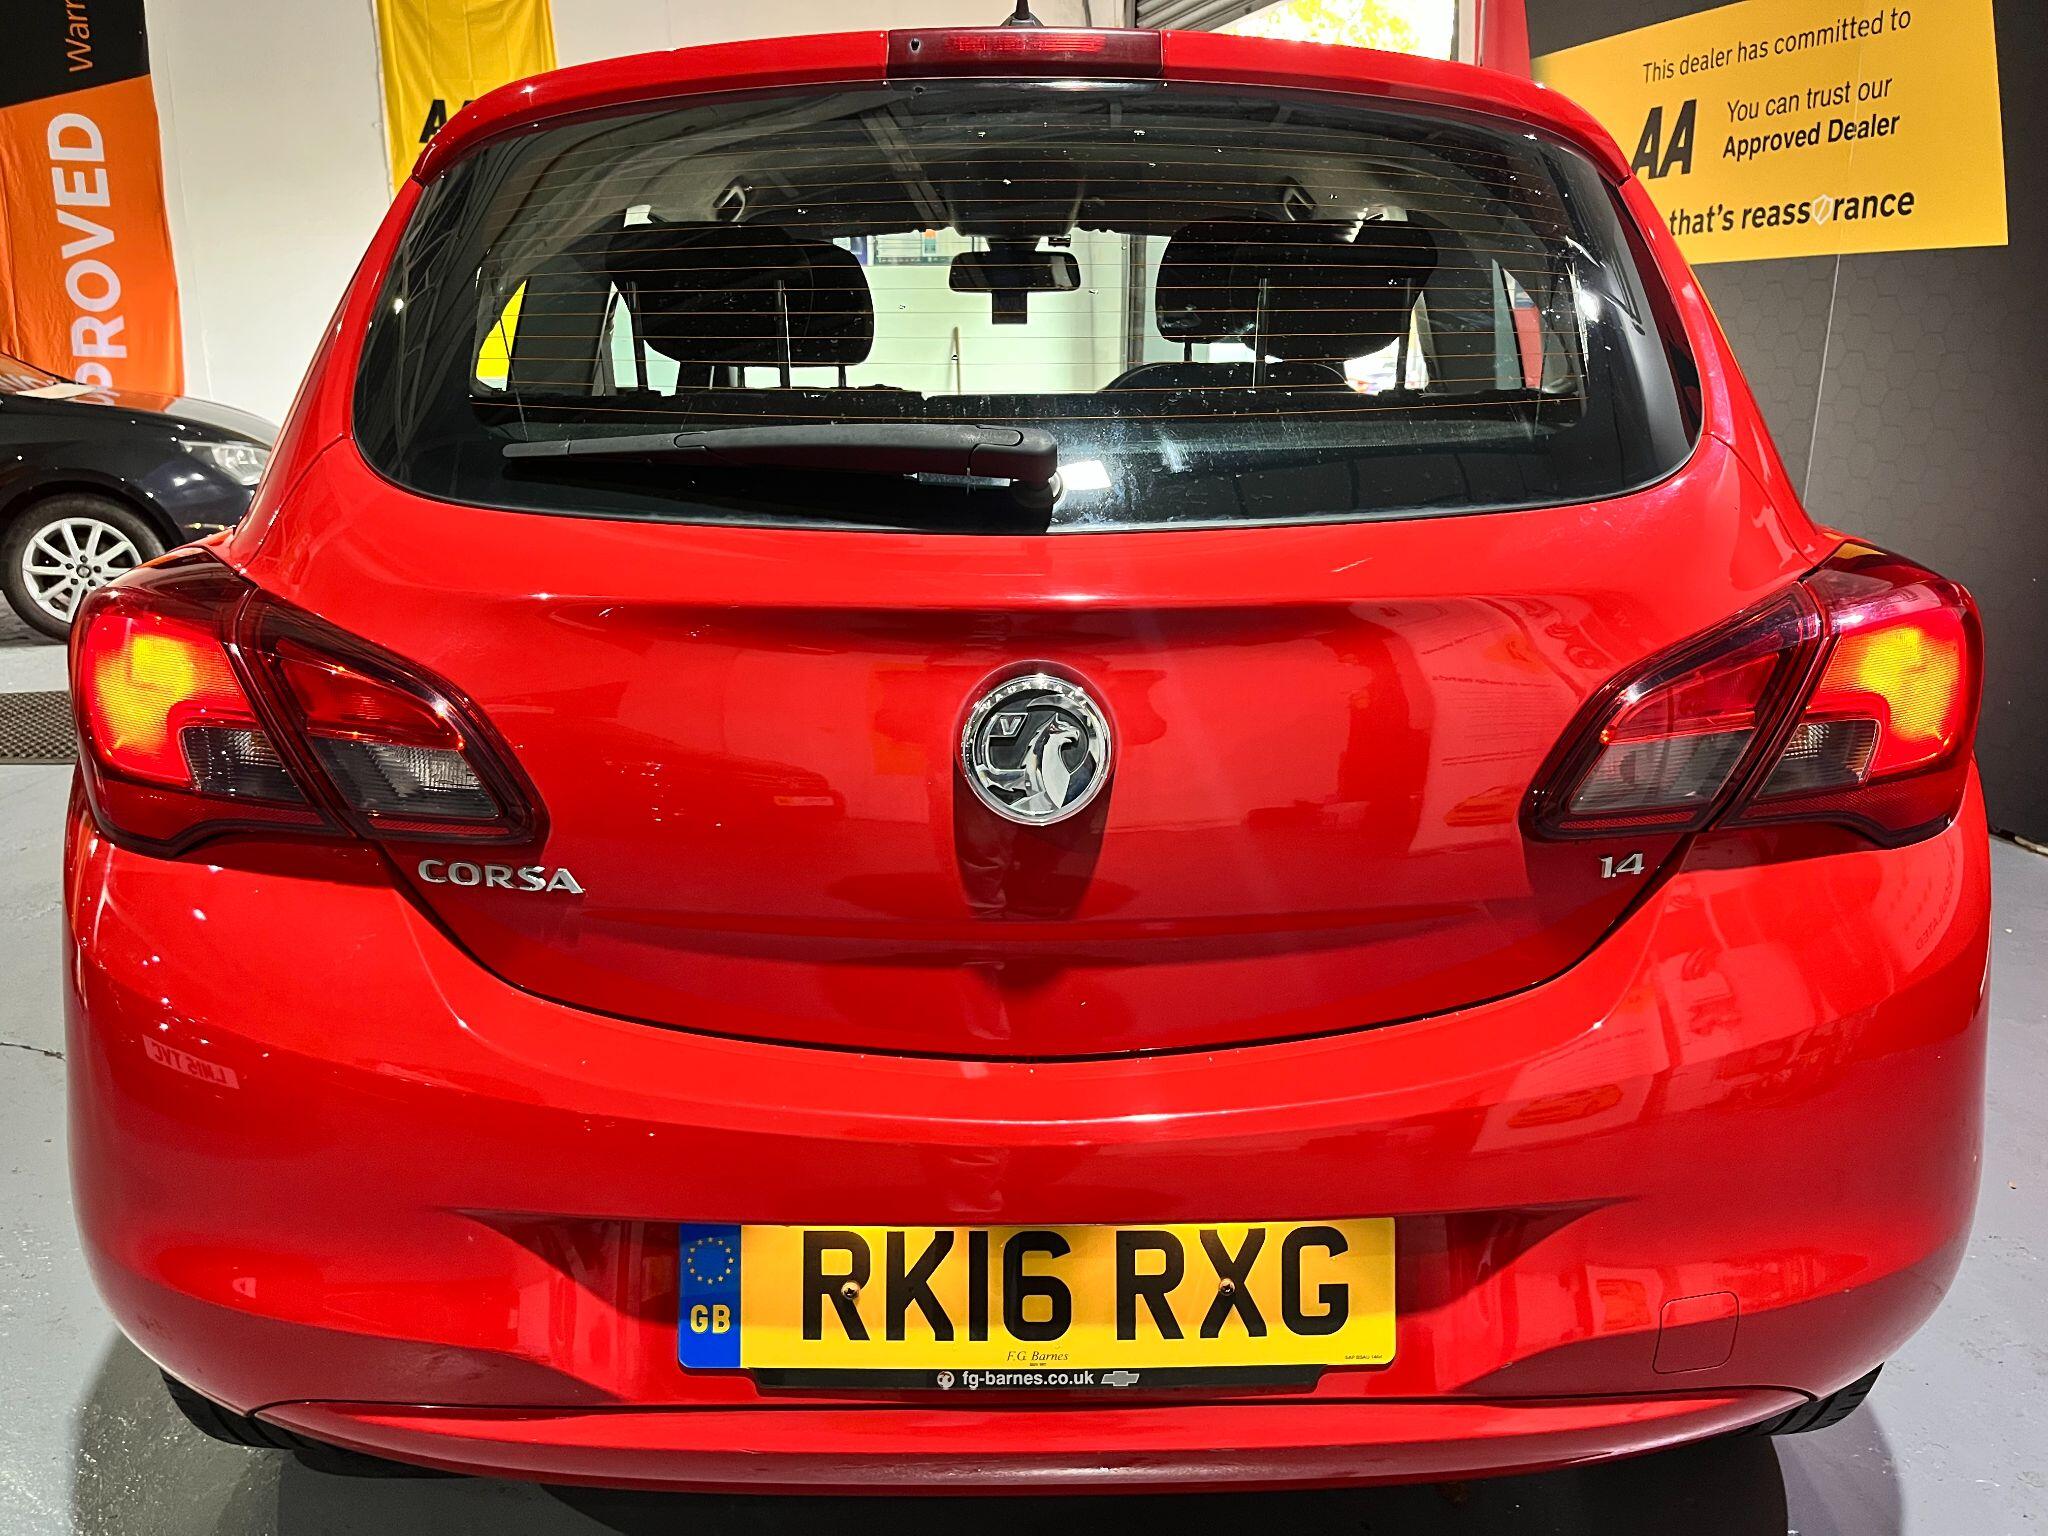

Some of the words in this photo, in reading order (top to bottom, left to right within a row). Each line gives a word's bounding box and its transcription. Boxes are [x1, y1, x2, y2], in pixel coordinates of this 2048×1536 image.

[1643, 59, 1675, 84] This
[1679, 47, 1733, 76] dealer
[1737, 41, 1769, 63] has
[1774, 10, 1884, 55] committed
[1890, 8, 1911, 31] to
[1727, 99, 1760, 123] You
[1765, 94, 1800, 117] can
[1806, 81, 1851, 110] trust
[1857, 78, 1893, 102] our
[419, 99, 475, 144] A
[1630, 98, 1697, 180] AA
[1722, 121, 1821, 162] Approved
[1828, 113, 1900, 143] Dealer
[1669, 203, 1735, 236] that's
[417, 859, 585, 894] CORSA
[1600, 853, 1645, 879] 1.4
[802, 1230, 1072, 1342] RK16
[1115, 1226, 1350, 1342] RXG
[689, 1304, 732, 1335] GB
[1031, 1350, 1069, 1361] Barnes
[962, 1370, 1094, 1390] fg-barnes.co.uk
